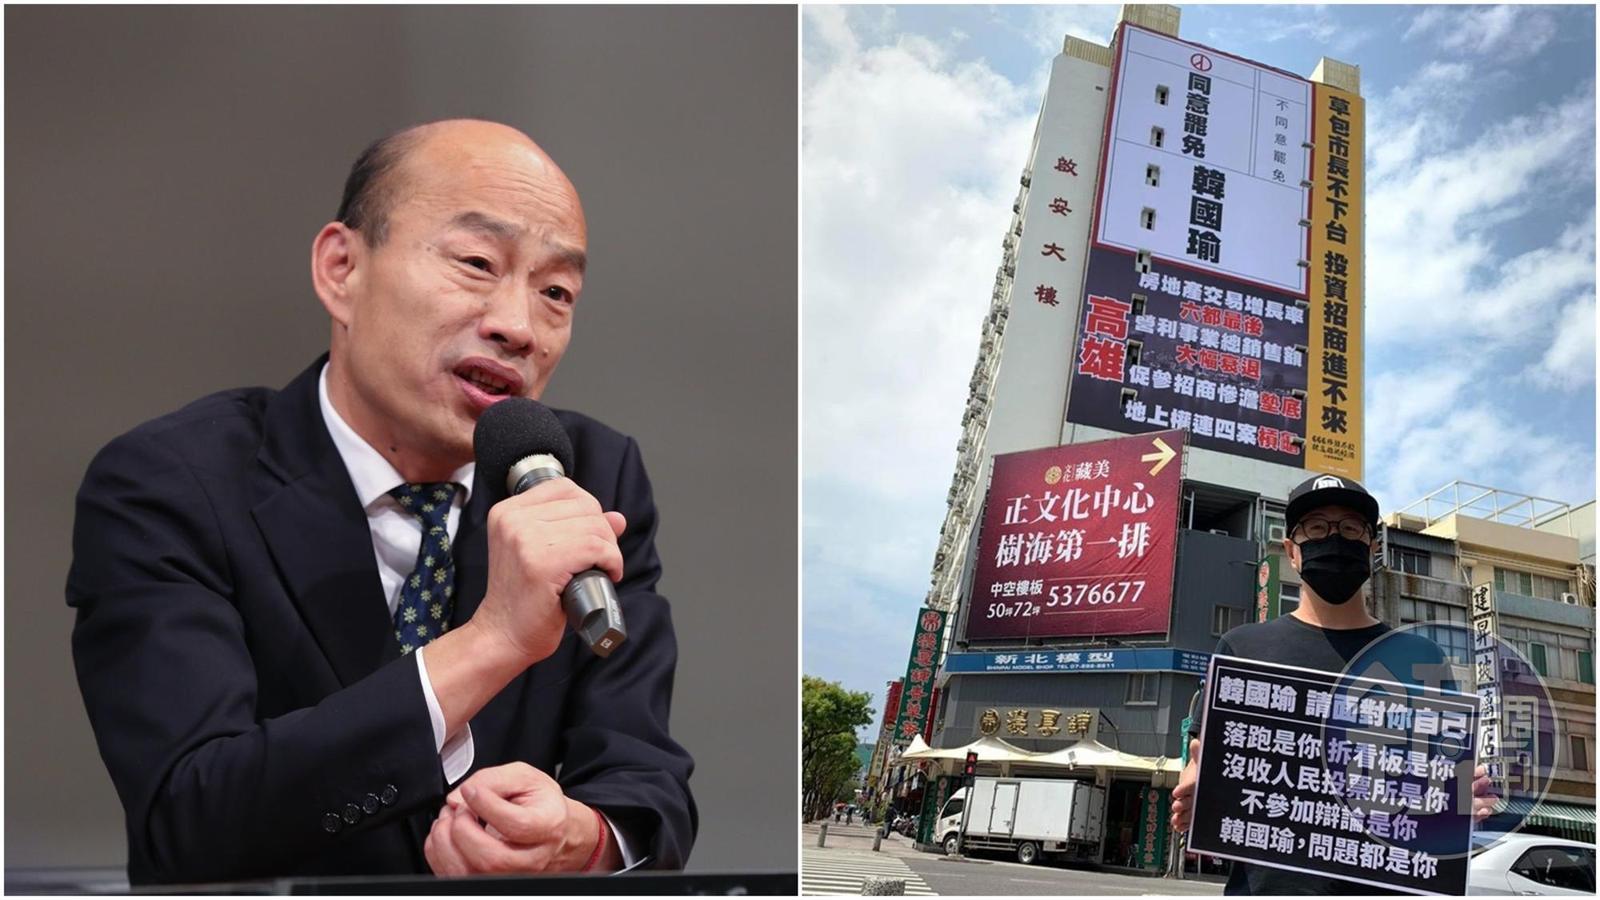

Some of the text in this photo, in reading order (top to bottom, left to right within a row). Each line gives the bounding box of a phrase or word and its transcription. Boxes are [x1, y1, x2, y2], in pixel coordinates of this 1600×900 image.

[1182, 71, 1211, 158] 同意罷免
[1272, 99, 1289, 183] 不同意罷免
[1326, 95, 1350, 245] 草包市長不下台
[1186, 165, 1226, 264] 韓國瑜
[1138, 272, 1305, 324] 房地產交易增長率
[1179, 300, 1264, 337] 六都最後
[1079, 295, 1131, 383] 高雄
[1134, 314, 1303, 367] 營利事業總銷售額
[1176, 344, 1262, 379] 大幅衰退
[1321, 251, 1349, 434] 投資招商進不來
[1074, 459, 1110, 481] 藏美
[1000, 482, 1155, 526] 正文化中心
[994, 522, 1151, 568] 樹海第一排
[990, 579, 1044, 598] 中空樓板
[1046, 581, 1145, 607] 5376677
[994, 652, 1115, 665] 新北模型
[1218, 675, 1467, 741] 韓國瑜 請面對你自己
[1223, 720, 1456, 782] 落跑是你 拆看板是你
[1222, 753, 1450, 813] 沒收人民投票所是你
[1241, 788, 1419, 842] 不參加辯論是你
